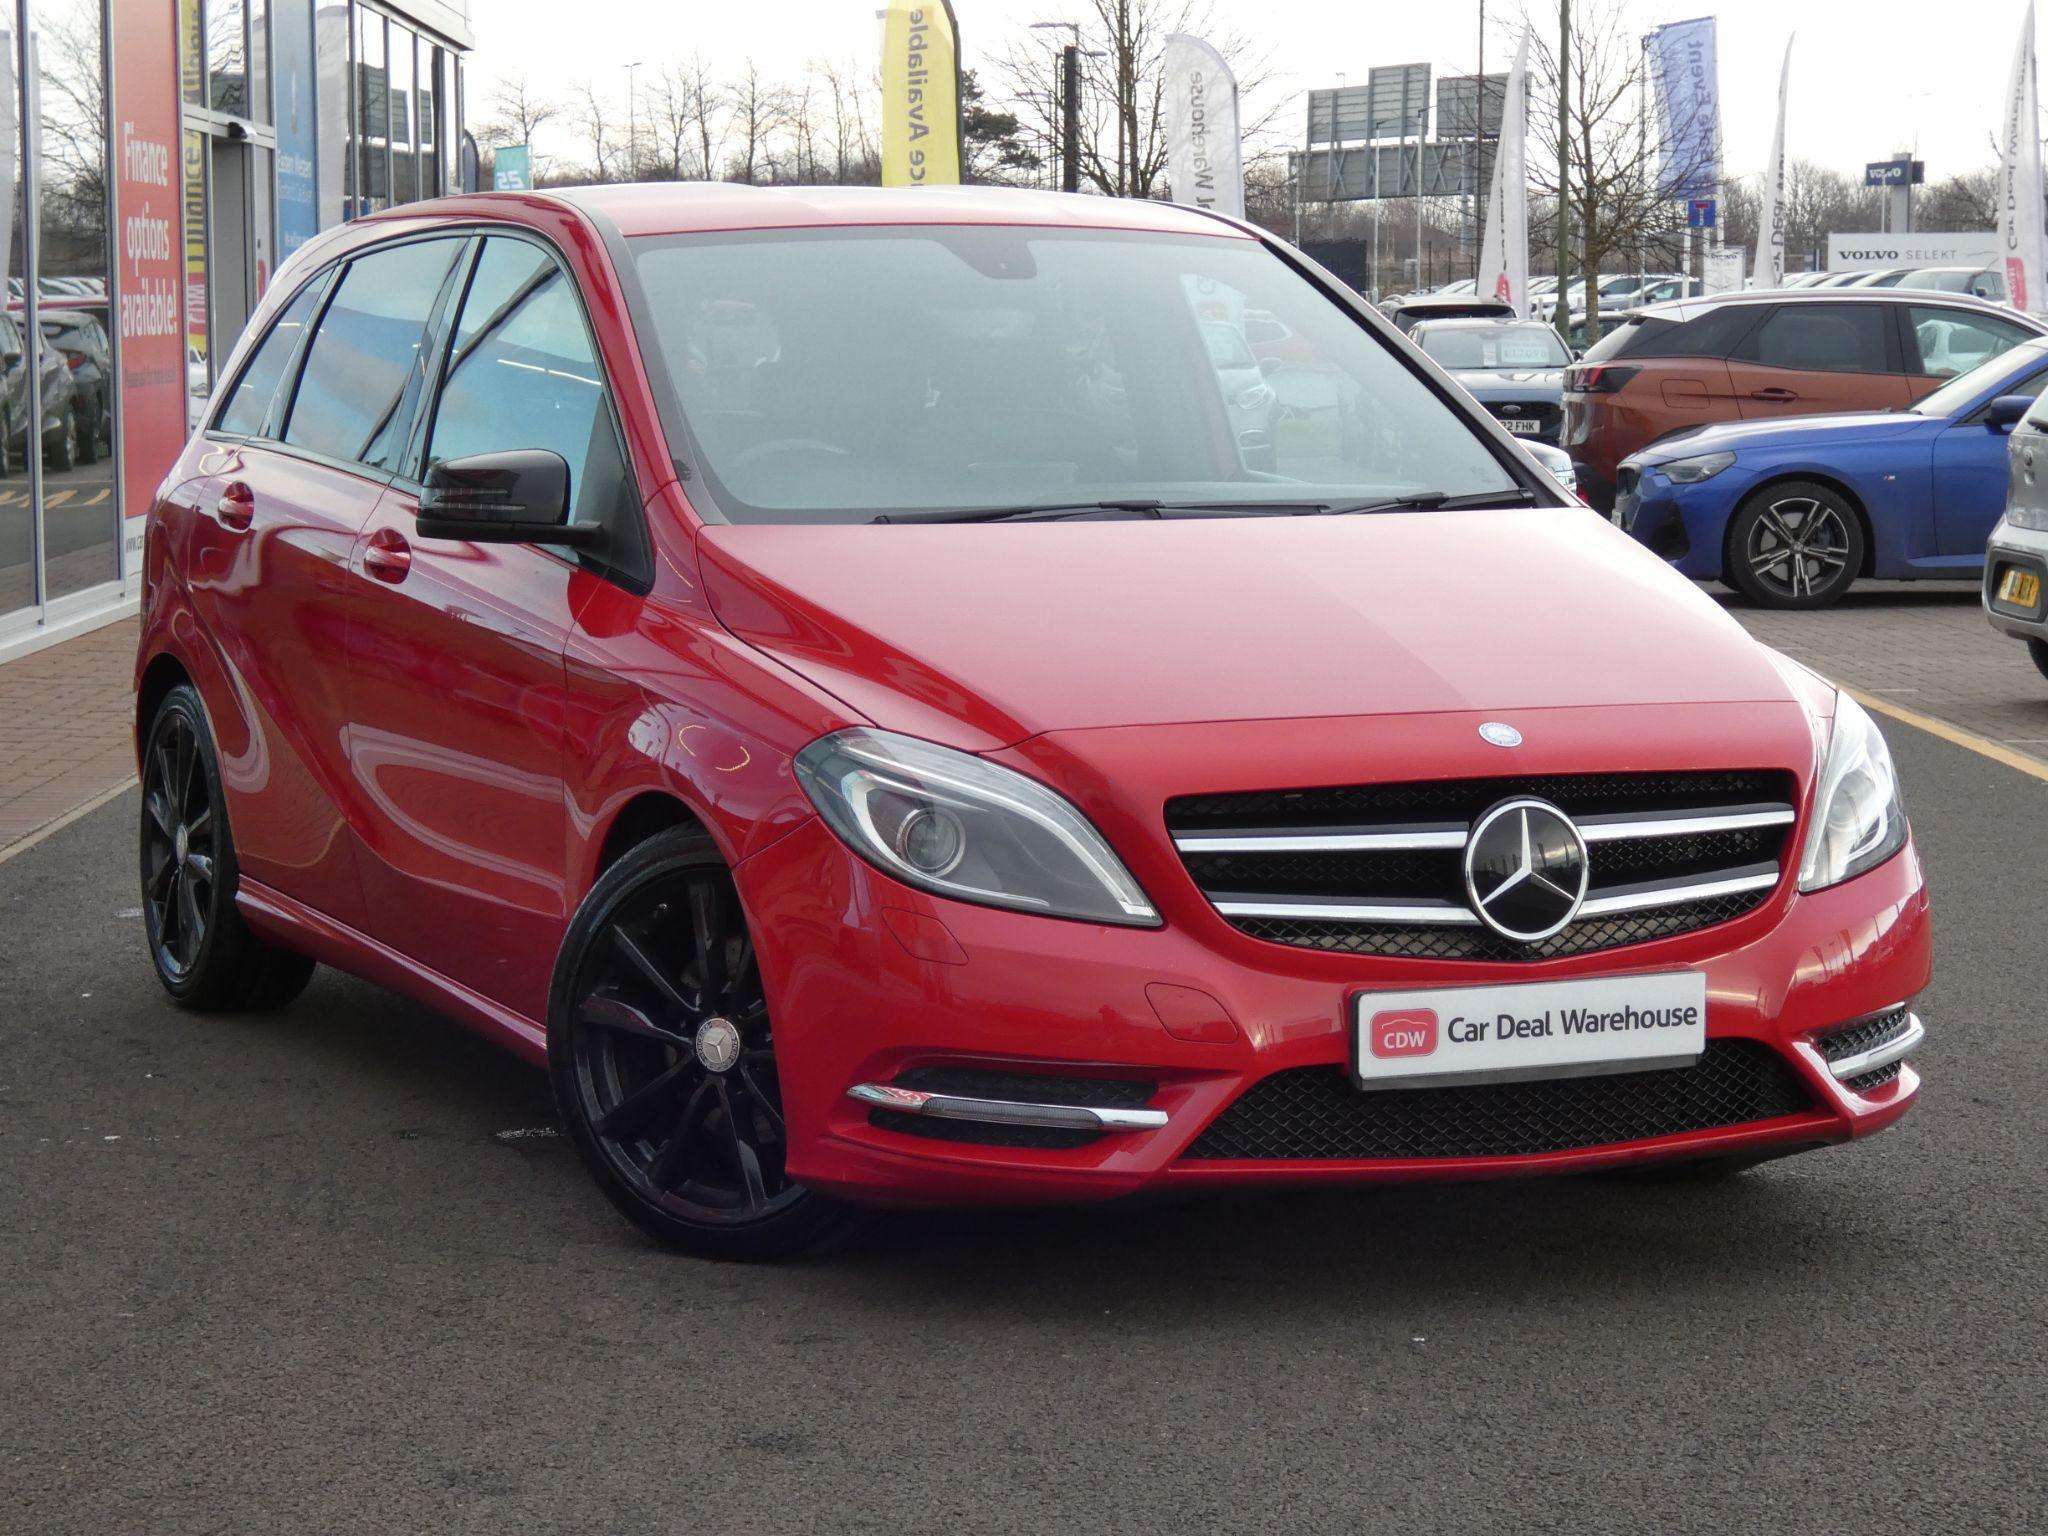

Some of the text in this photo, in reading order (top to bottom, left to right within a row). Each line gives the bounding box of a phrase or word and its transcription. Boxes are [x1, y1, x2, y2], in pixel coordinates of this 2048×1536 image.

[124, 121, 168, 187] Finance
[127, 200, 170, 278] options
[1839, 250, 1957, 260] VOLVO SELEKT
[1515, 421, 1535, 431] FHK
[1447, 1005, 1698, 1044] Car Deal Warehouse
[1384, 1030, 1425, 1050] CDW
